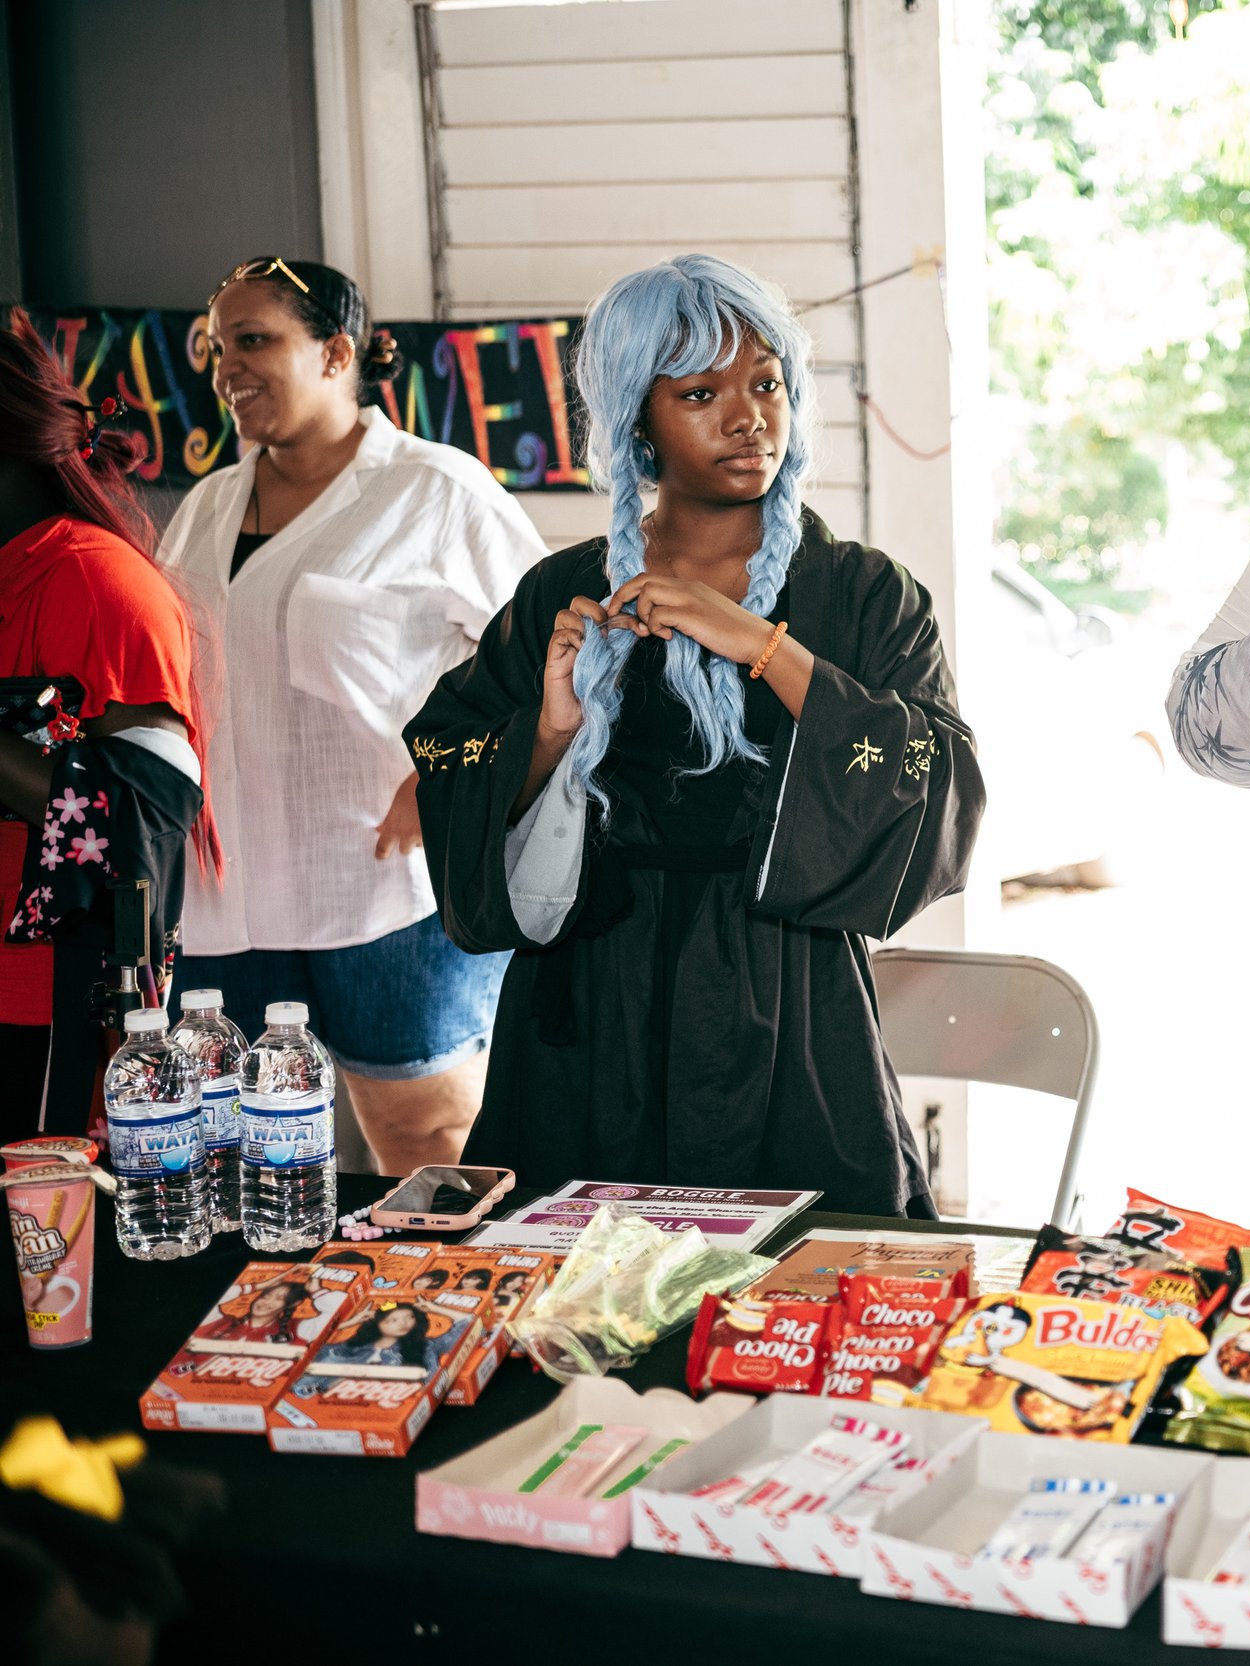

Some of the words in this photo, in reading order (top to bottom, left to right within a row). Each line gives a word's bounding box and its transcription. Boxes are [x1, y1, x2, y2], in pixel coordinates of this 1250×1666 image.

[144, 1129, 198, 1151] WATA
[252, 1127, 308, 1141] WATA
[650, 1189, 746, 1200] BOGGLE
[861, 1303, 936, 1327] Choco
[772, 1317, 821, 1345] Pie
[734, 1339, 817, 1368] Choco
[194, 1354, 293, 1387] PEPERO
[321, 1379, 422, 1409] PEPERO
